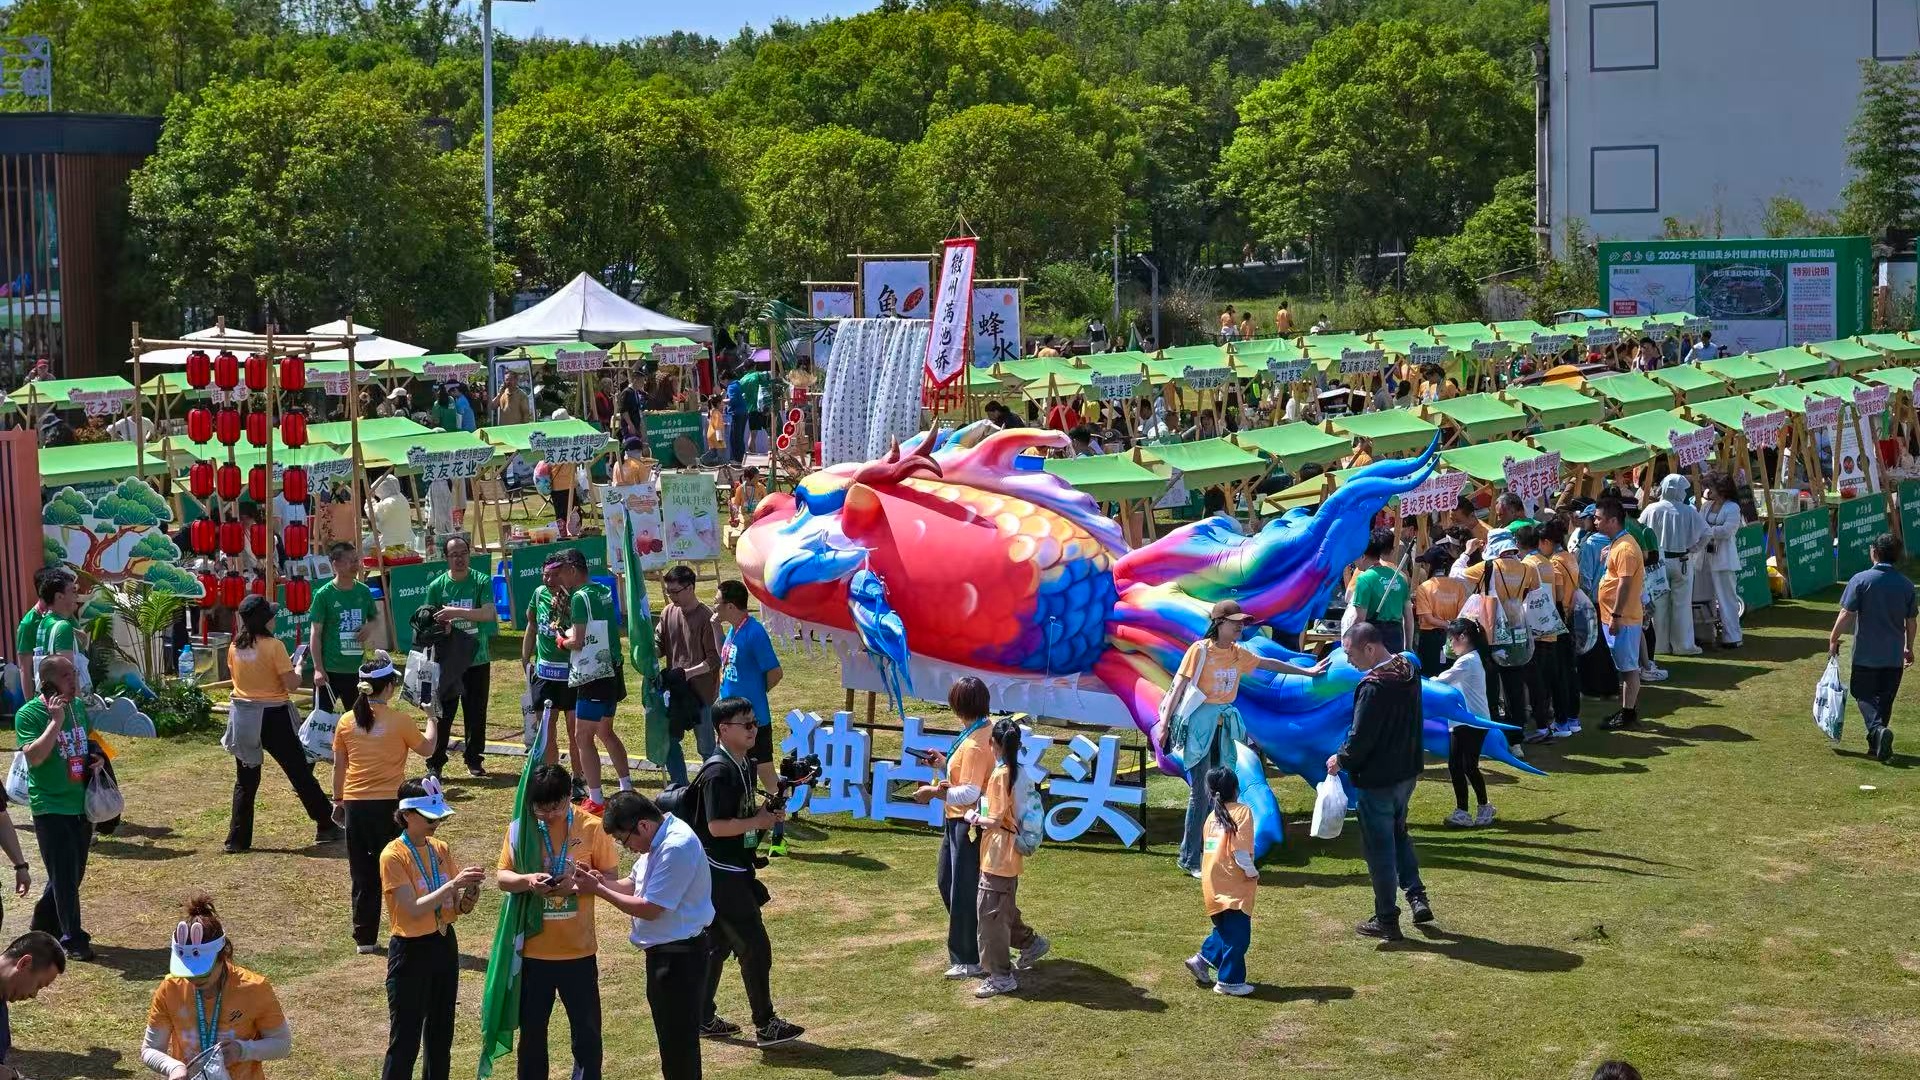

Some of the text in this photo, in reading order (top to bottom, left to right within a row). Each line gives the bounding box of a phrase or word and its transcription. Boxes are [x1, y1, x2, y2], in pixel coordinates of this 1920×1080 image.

[86, 400, 122, 415] 花之韵
[545, 445, 594, 463] 赏友花业
[424, 460, 477, 479] 赏友花业
[1401, 490, 1457, 516] 呈坎罗氏毛豆腐
[339, 609, 362, 621] 中国
[779, 708, 1146, 850] 独占头
